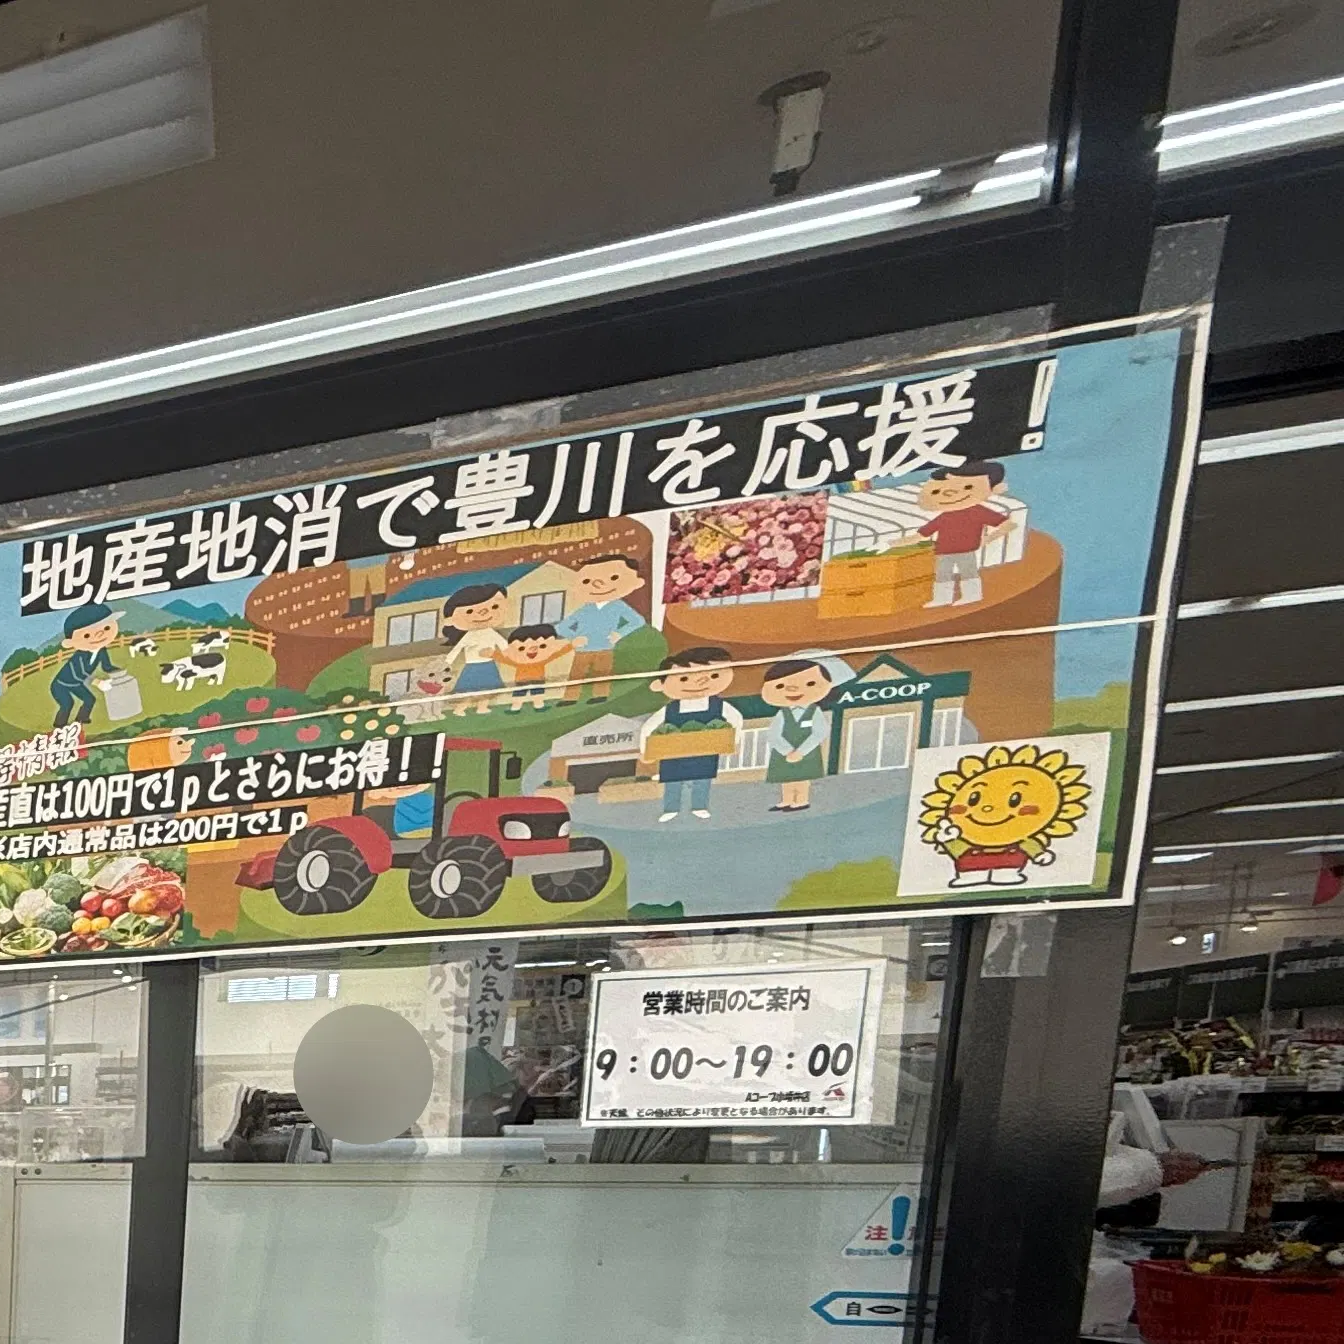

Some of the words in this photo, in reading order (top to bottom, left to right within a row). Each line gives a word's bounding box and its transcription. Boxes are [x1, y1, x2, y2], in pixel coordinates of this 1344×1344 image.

[22, 360, 1058, 611] 地産地消で豊川を応援！
[836, 682, 932, 704] A-COOP
[583, 731, 633, 746] 直売所
[642, 986, 811, 1016] 営業時間のご案内
